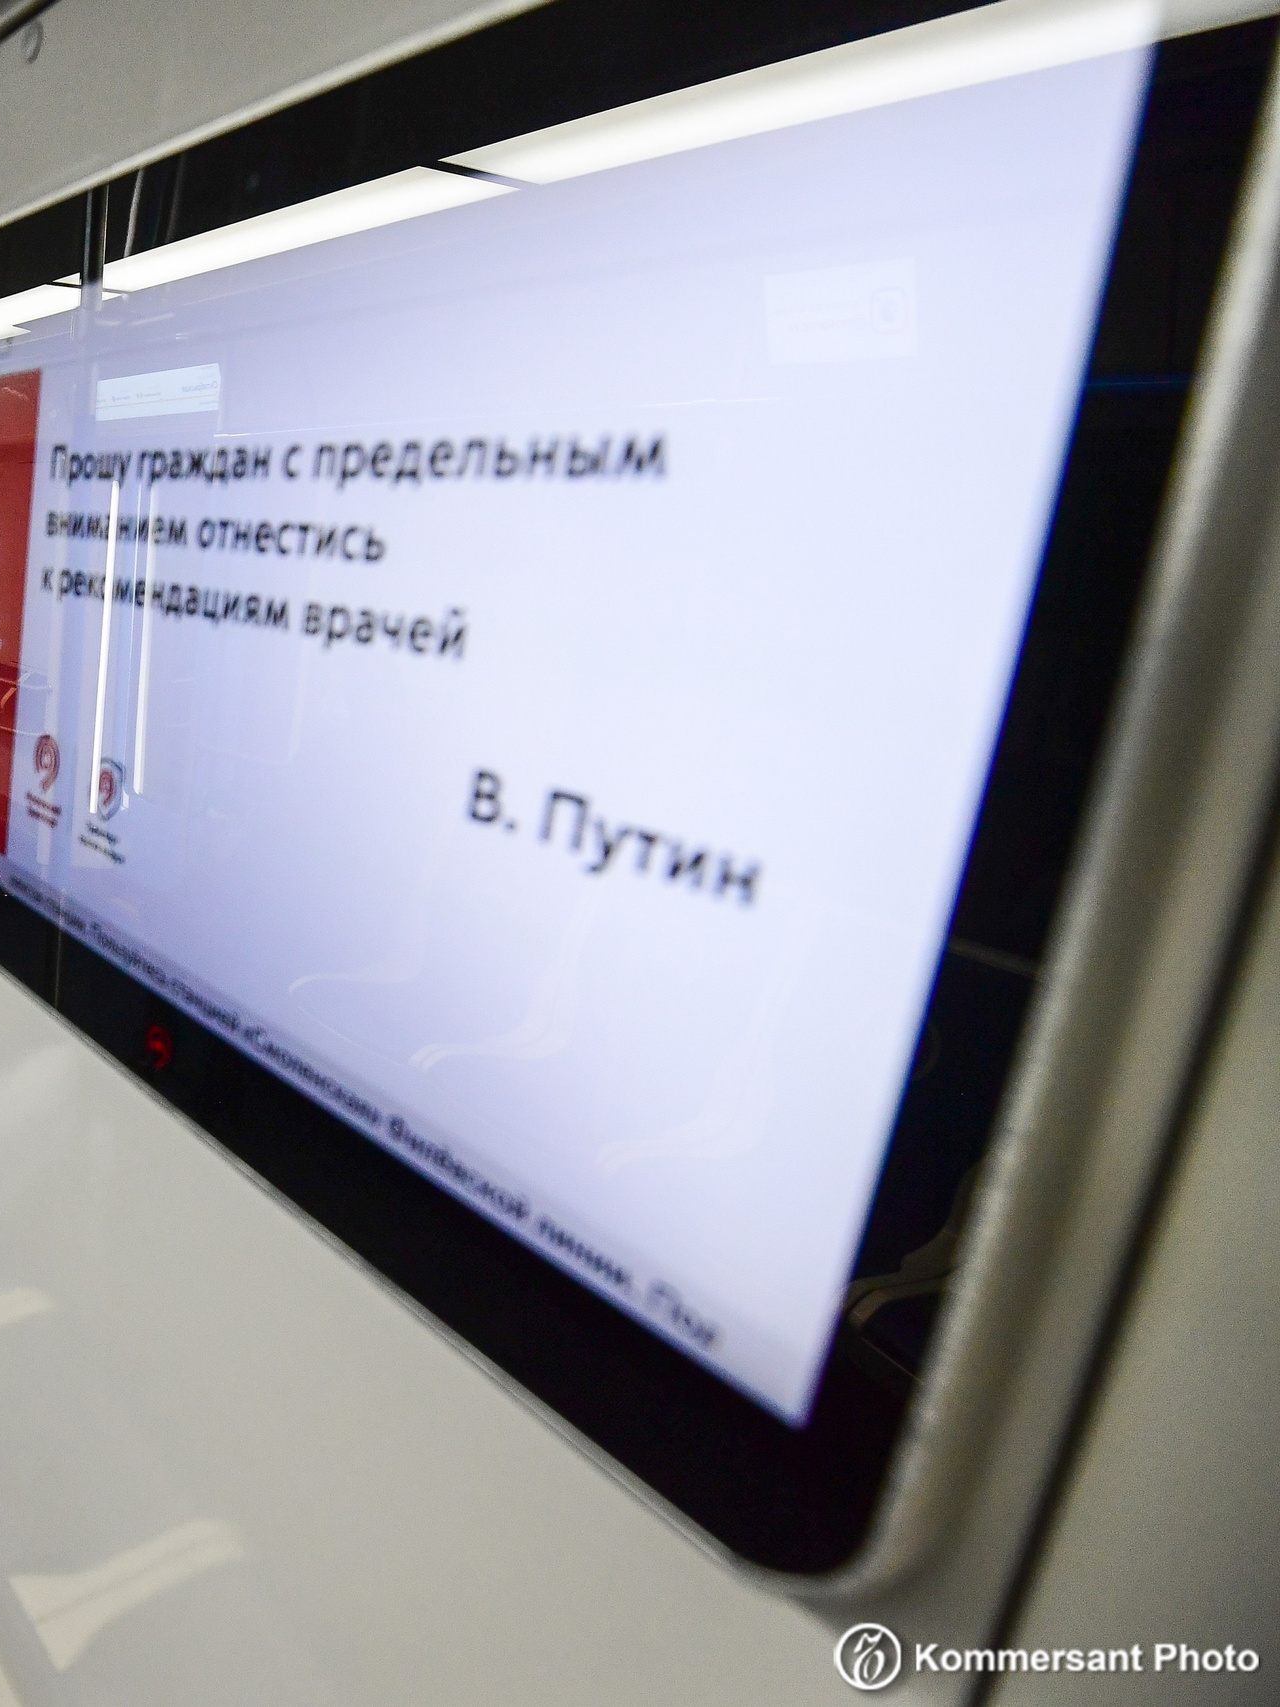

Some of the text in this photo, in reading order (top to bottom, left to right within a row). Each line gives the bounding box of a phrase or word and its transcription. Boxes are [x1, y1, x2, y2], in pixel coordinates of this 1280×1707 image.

[50, 430, 669, 489] Прошу граждан с предельным
[45, 505, 387, 564] вниманием отнестись
[40, 566, 468, 662] к рекомендациям врачей
[467, 766, 762, 906] В. Путин
